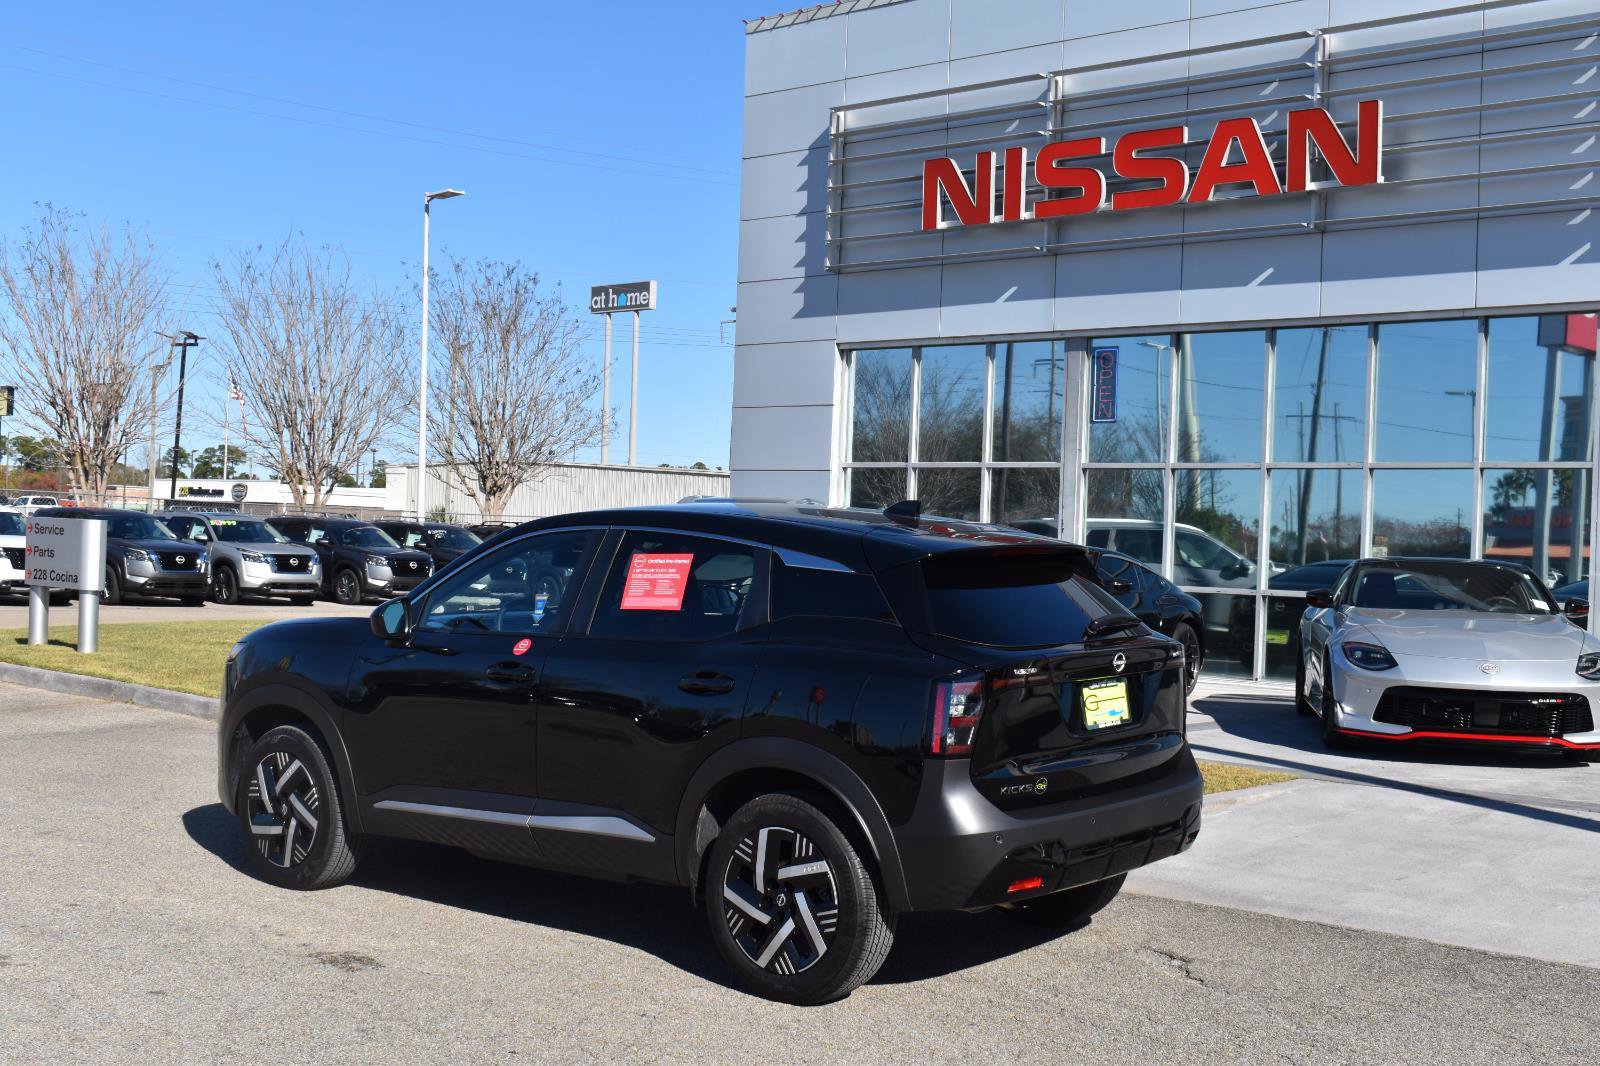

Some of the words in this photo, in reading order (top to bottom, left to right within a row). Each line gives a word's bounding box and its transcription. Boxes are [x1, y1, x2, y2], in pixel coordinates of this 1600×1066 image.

[921, 99, 1384, 231] NISSAN
[592, 292, 605, 309] at
[1098, 351, 1115, 418] OPEN
[34, 523, 65, 536] Service
[33, 545, 55, 558] Parts
[33, 568, 48, 580] 228
[49, 569, 79, 584] Cocina
[1000, 783, 1034, 796] KICKS
